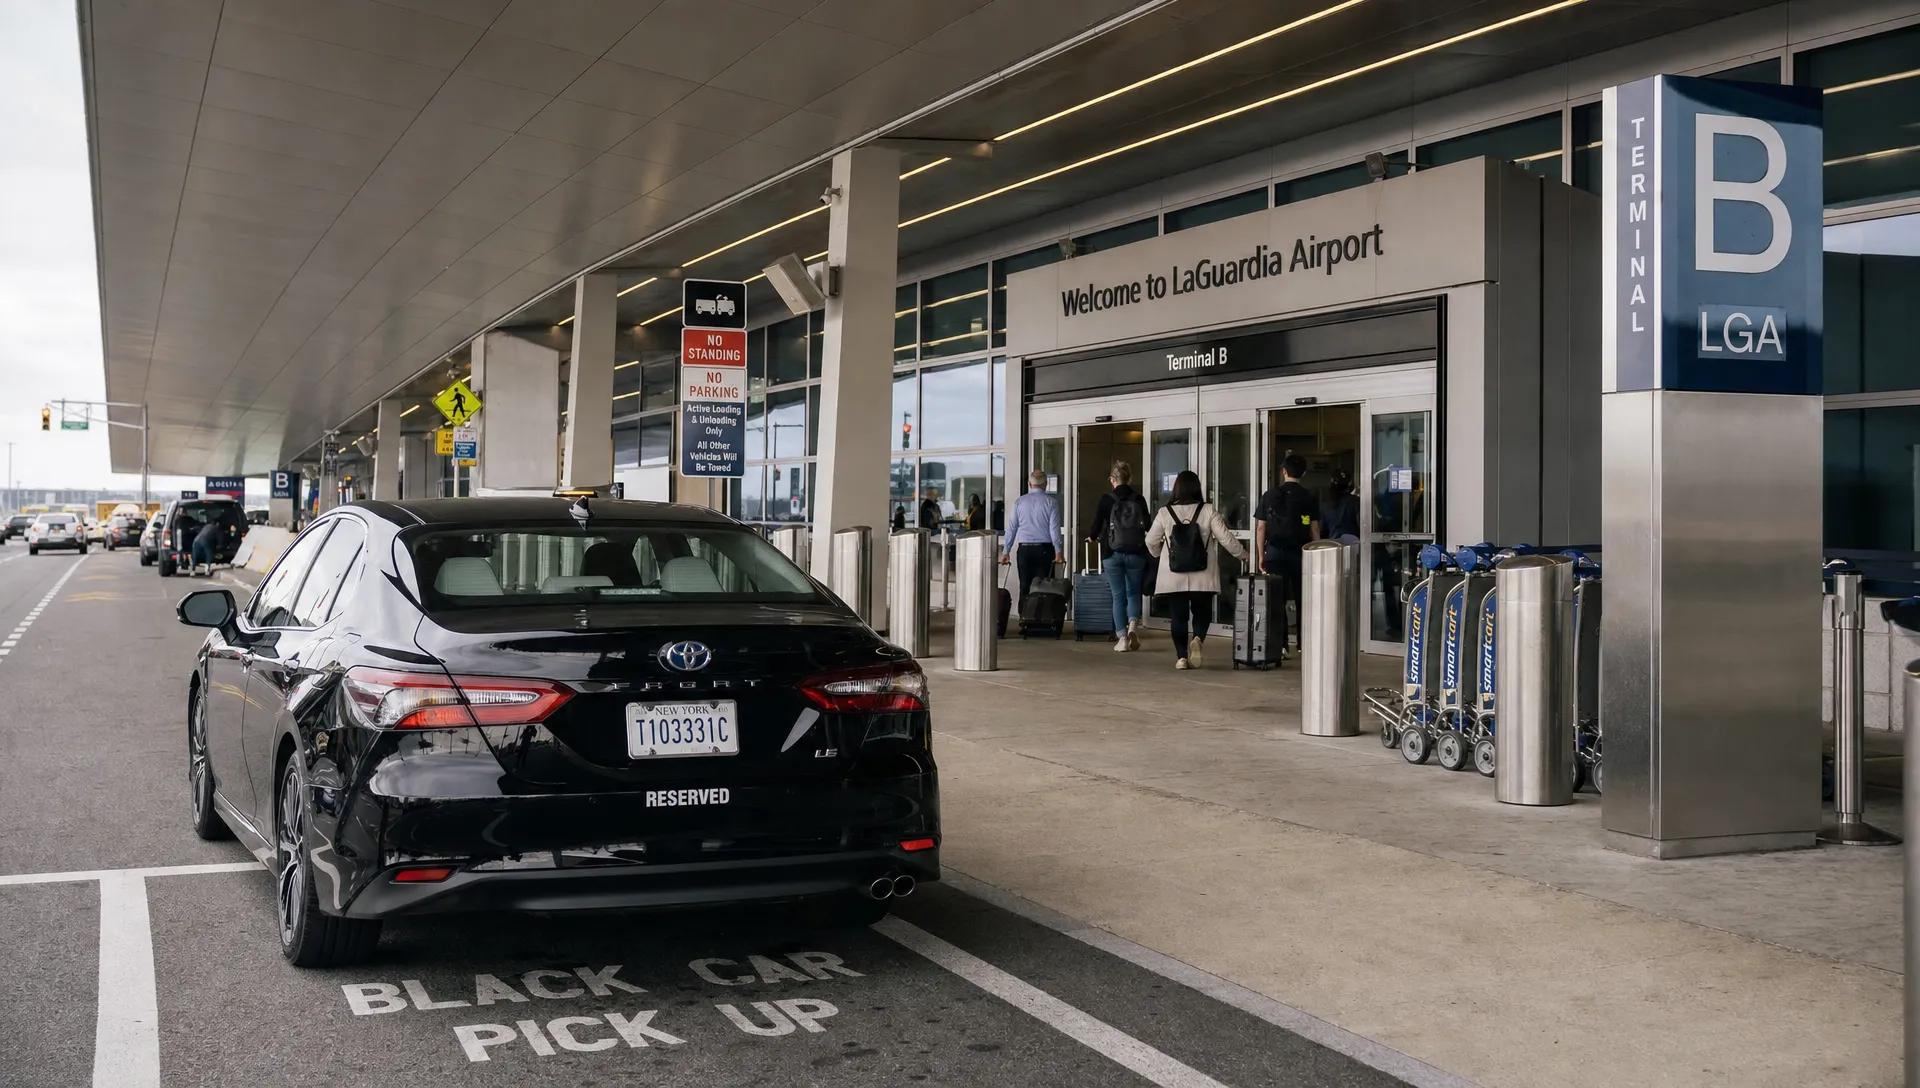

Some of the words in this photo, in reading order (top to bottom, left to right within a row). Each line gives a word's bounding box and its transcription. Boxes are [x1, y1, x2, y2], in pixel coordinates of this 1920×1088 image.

[1695, 113, 1792, 274] B
[1629, 116, 1647, 332] TERMINAL
[1062, 281, 1141, 316] Welcome
[1145, 273, 1166, 300] to
[1172, 245, 1282, 296] LaGuardia
[1289, 223, 1384, 275] Airport
[707, 335, 722, 346] NO
[1701, 311, 1783, 354] LGA
[688, 348, 741, 361] STANDING
[1166, 348, 1216, 371] Terminal
[1219, 346, 1228, 365] B
[707, 372, 722, 384] NO
[689, 385, 739, 398] PARKING
[687, 404, 711, 413] Active
[712, 405, 742, 416] Loading
[691, 416, 698, 424] &
[699, 416, 737, 426] Unloading
[705, 426, 723, 437] Only
[697, 441, 708, 450] All
[709, 441, 731, 450] Other
[690, 452, 722, 461] Vehicles
[723, 453, 737, 461] Will
[695, 463, 706, 471] Be
[707, 463, 731, 472] Towed
[276, 472, 289, 488] B
[1411, 603, 1421, 684] smartcart
[1446, 604, 1457, 688] smartcart
[1483, 608, 1494, 693] smartcart
[655, 706, 680, 716] NEW
[681, 705, 709, 715] YORK
[635, 716, 729, 746] T103331C
[645, 788, 730, 807] RESERVED
[342, 965, 648, 1016] BLACK
[689, 951, 866, 986] CAR
[454, 1009, 687, 1062] PICK
[716, 998, 840, 1037] UP
